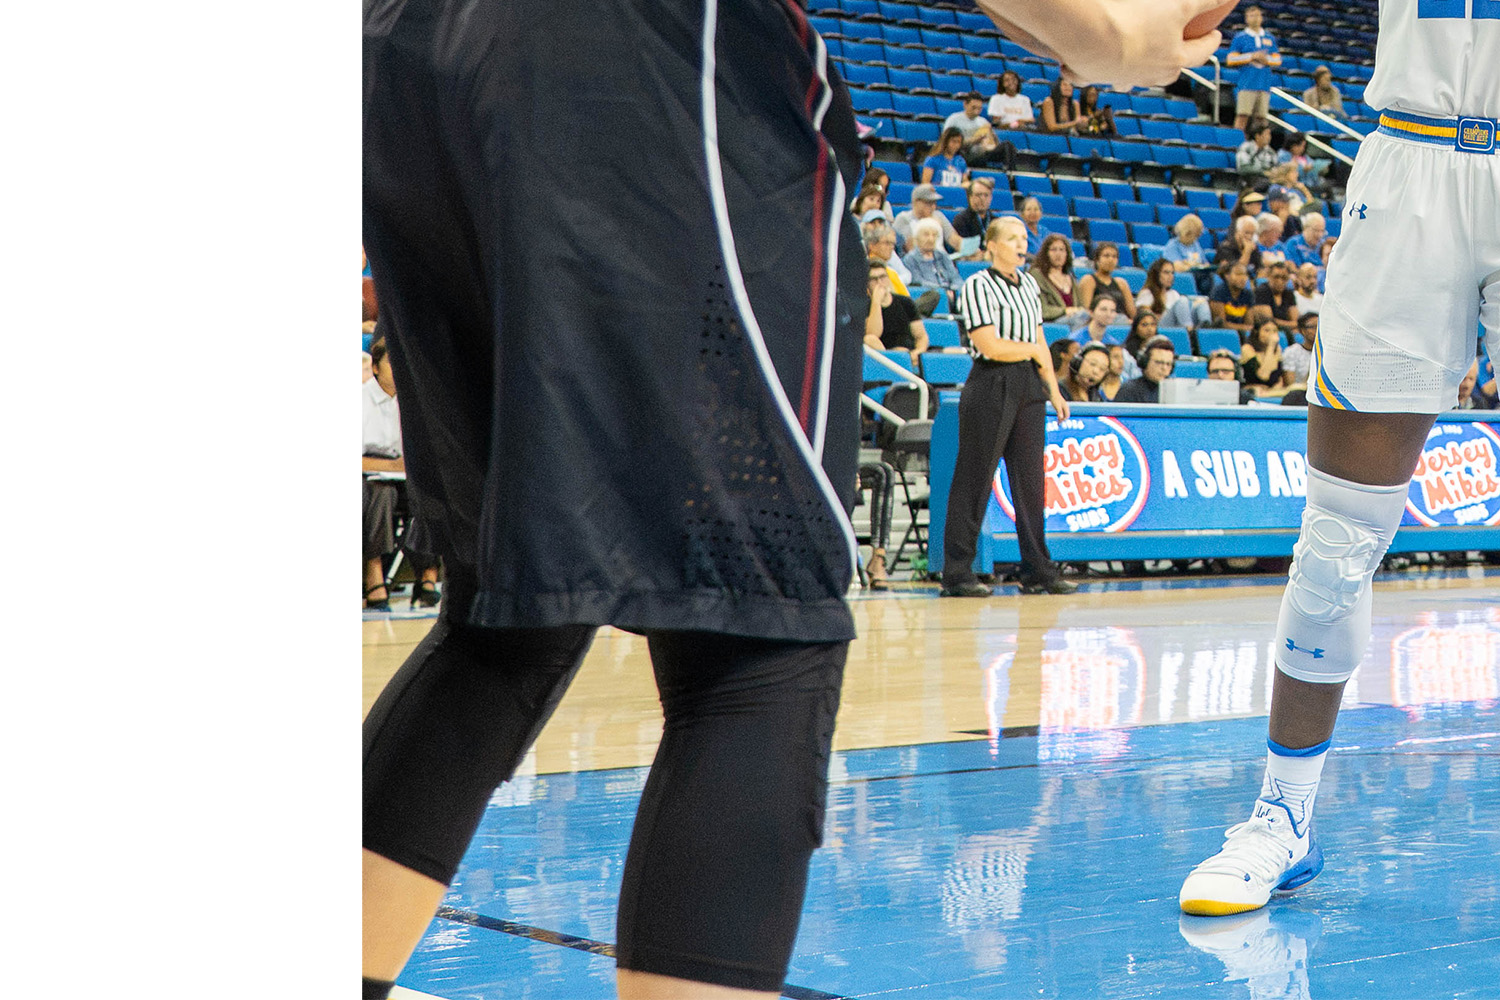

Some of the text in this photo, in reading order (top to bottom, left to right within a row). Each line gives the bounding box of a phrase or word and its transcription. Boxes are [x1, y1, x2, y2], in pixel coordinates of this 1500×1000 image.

[1162, 450, 1188, 498] A
[1191, 450, 1260, 498] SUB
[1066, 508, 1110, 532] SUBS
